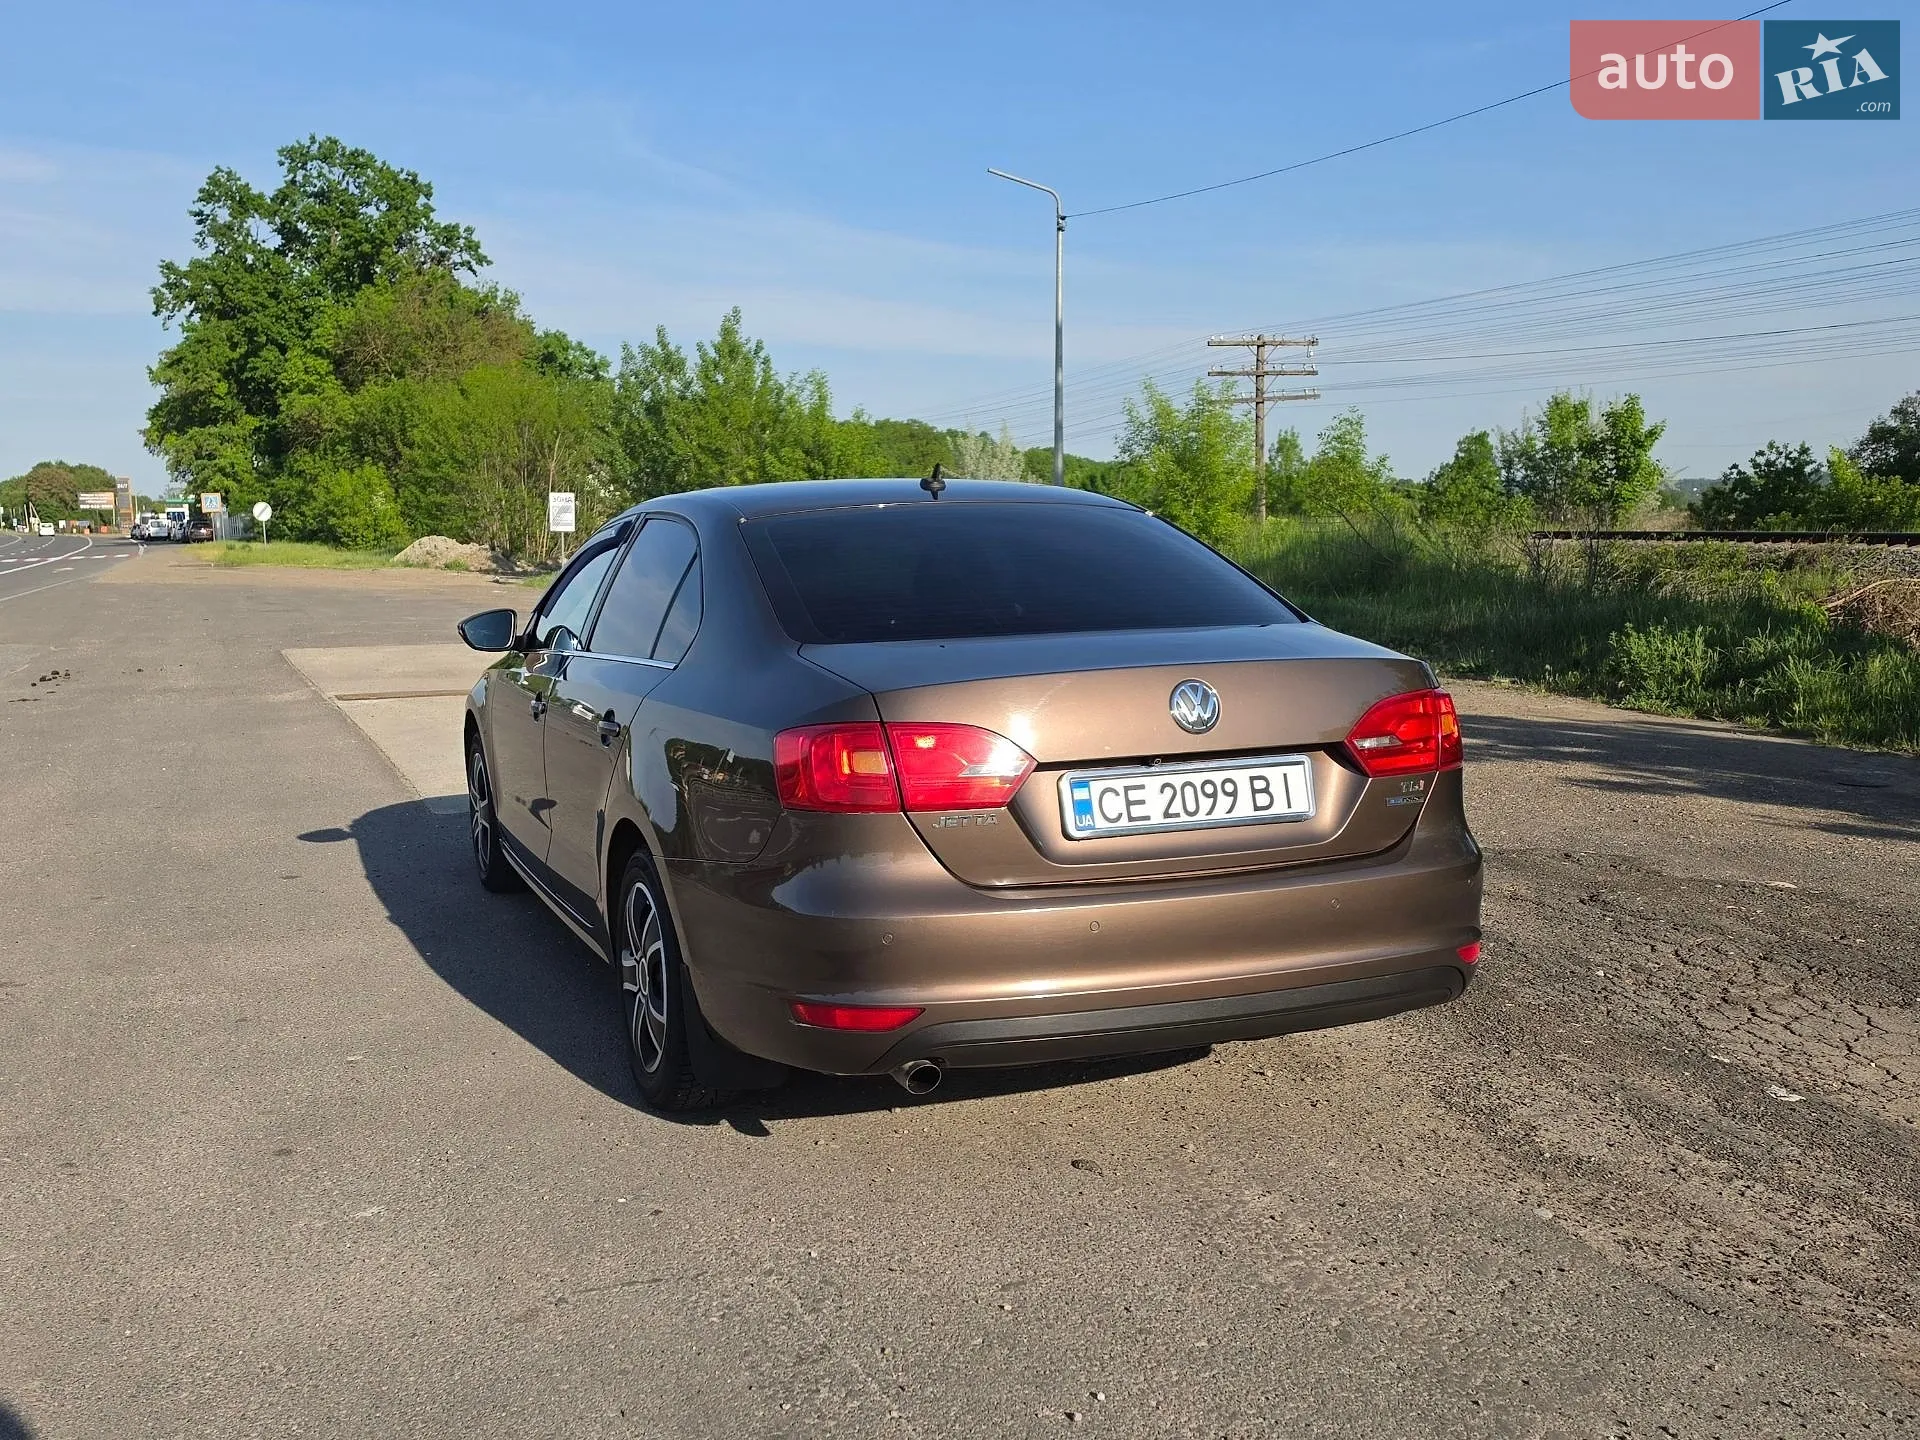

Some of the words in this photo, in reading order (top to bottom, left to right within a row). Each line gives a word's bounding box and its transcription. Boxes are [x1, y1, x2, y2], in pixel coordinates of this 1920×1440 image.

[1098, 784, 1151, 824] CE
[1159, 777, 1239, 820] 2099
[1249, 772, 1293, 812] BI
[932, 813, 999, 829] JETTA
[1076, 814, 1095, 828] UA
